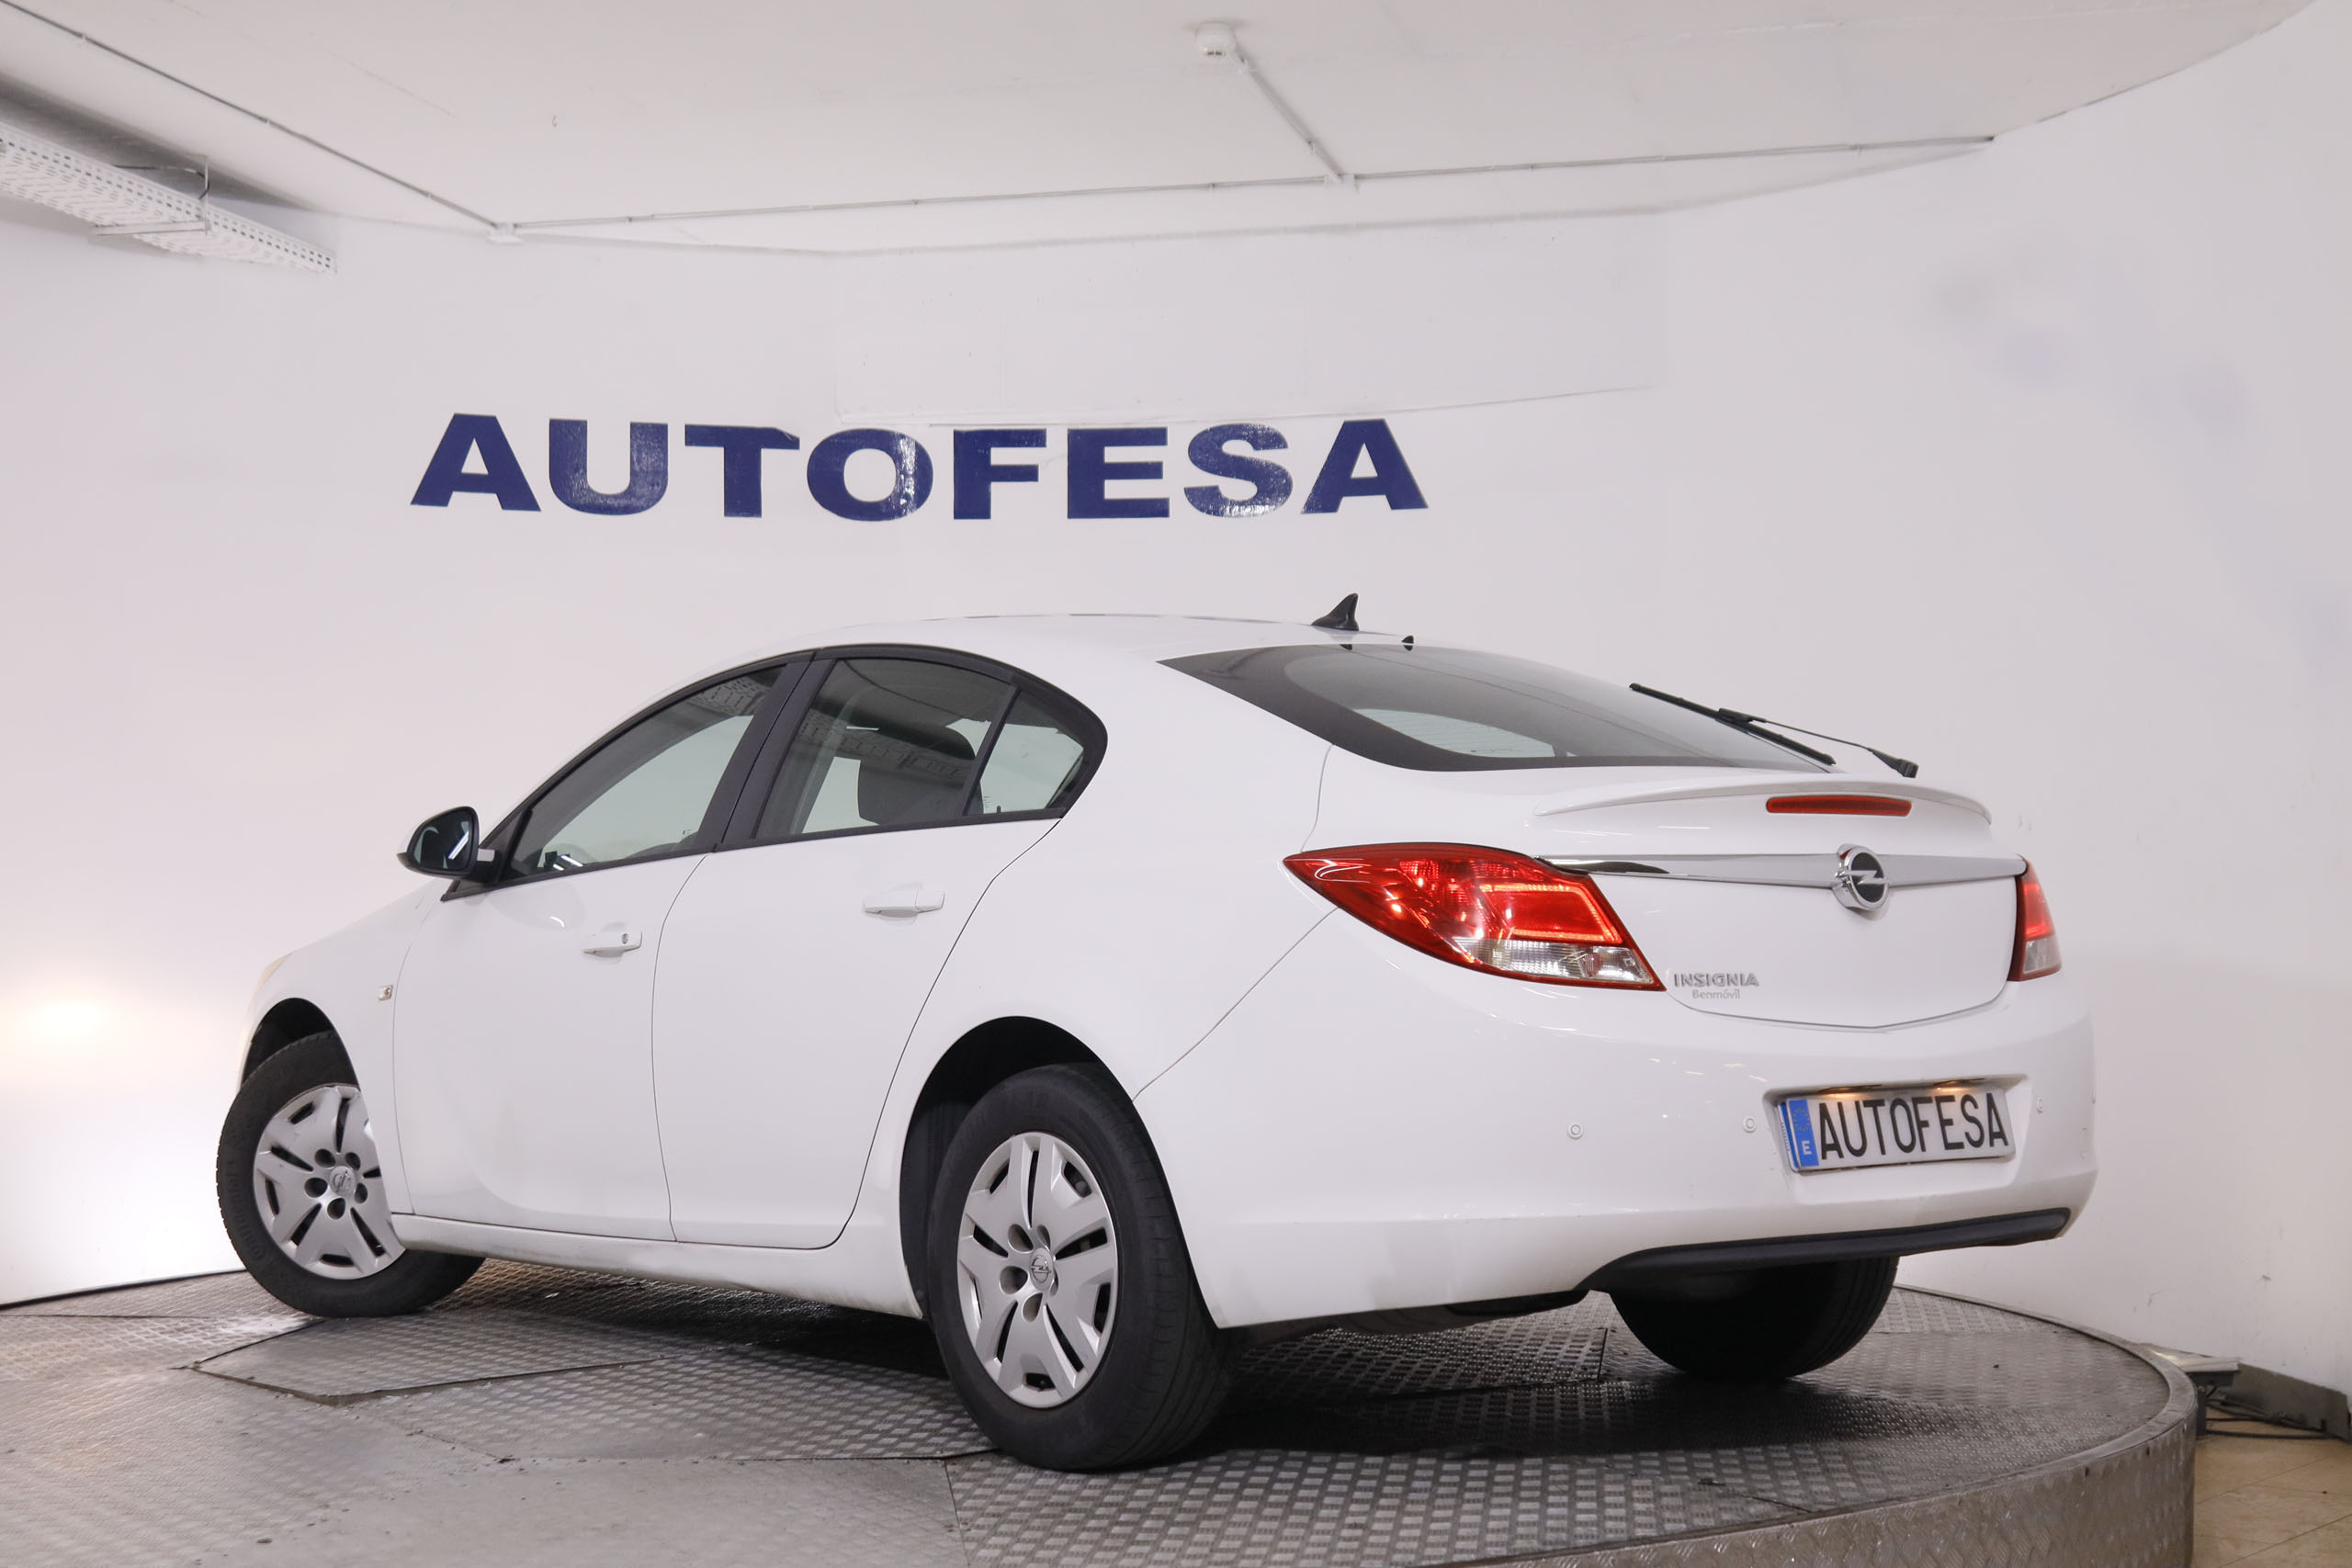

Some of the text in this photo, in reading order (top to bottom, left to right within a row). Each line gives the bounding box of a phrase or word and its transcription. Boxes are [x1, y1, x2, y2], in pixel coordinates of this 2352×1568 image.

[412, 414, 1429, 522] AUTOFESA
[1674, 973, 1760, 987] INSIGNIA
[1802, 1140, 1812, 1155] E
[1818, 1092, 2009, 1160] AUTOFESA
